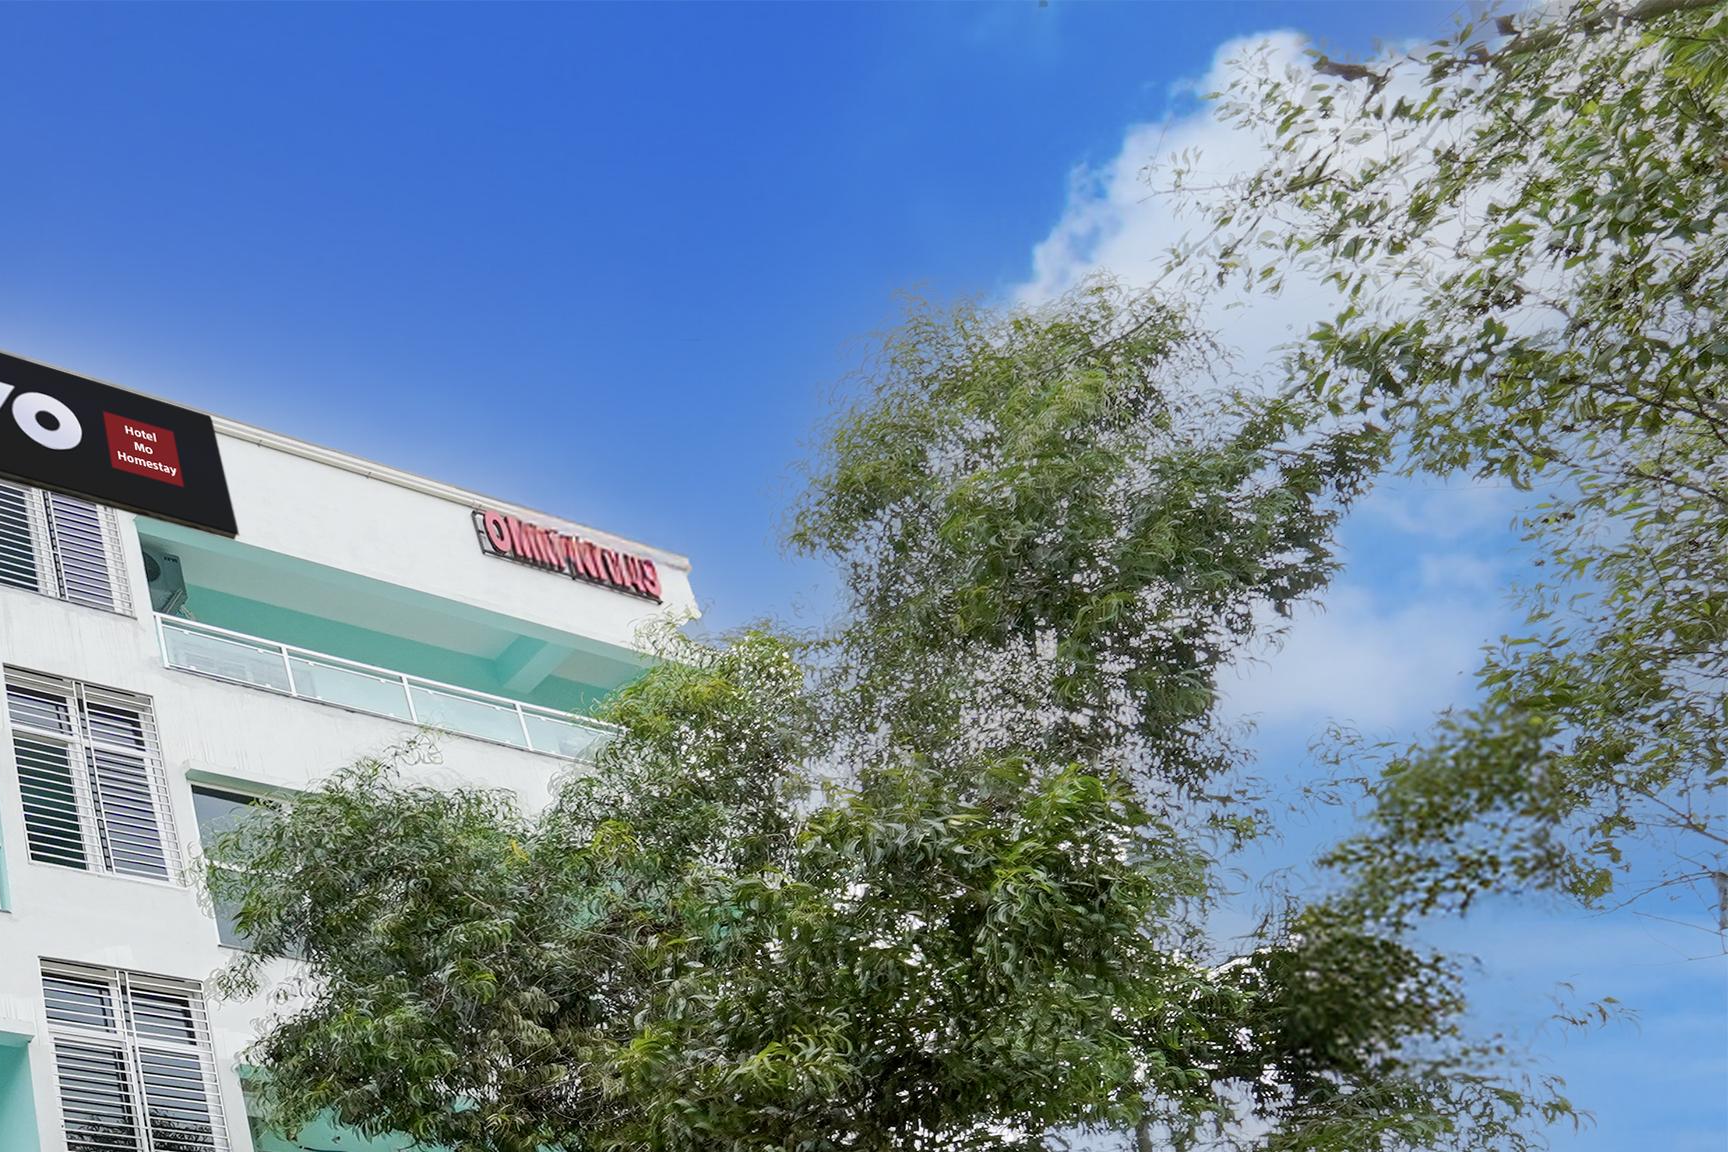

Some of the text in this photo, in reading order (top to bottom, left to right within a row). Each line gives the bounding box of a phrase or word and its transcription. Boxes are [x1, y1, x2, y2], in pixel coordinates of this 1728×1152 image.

[124, 425, 157, 442] Hotel
[134, 442, 153, 455] Mo
[117, 451, 177, 476] Homestay
